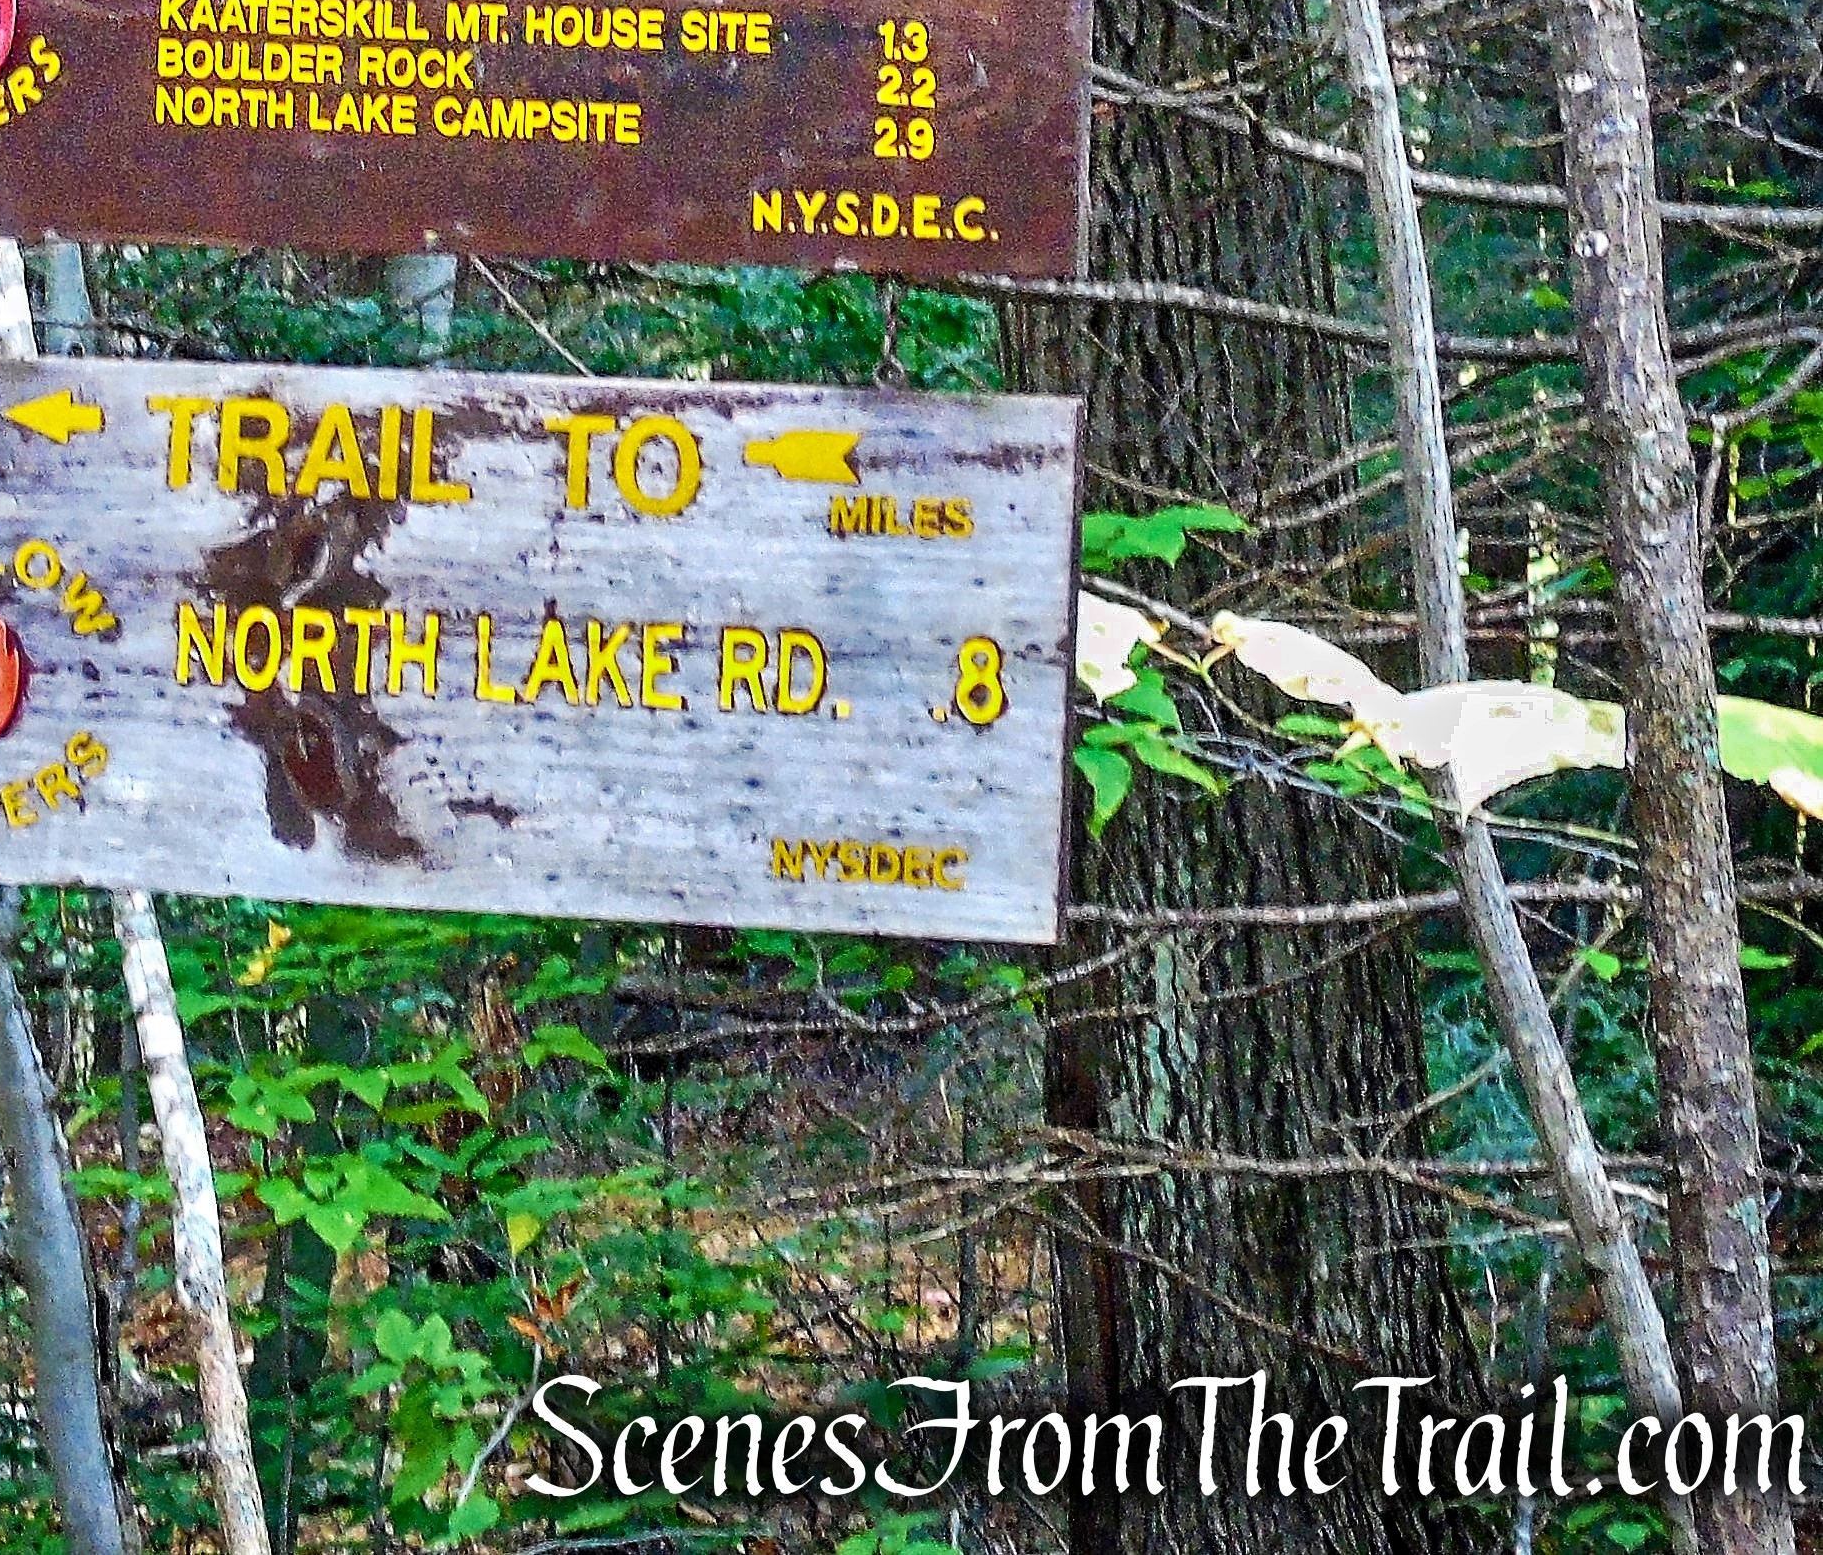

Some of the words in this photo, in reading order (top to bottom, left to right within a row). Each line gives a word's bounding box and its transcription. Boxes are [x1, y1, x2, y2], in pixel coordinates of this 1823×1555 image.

[445, 3, 510, 45] MT.
[524, 6, 664, 51] HOUSE
[680, 12, 774, 55] SITE
[879, 20, 929, 62] 1.3
[156, 38, 342, 85] BOULDER
[359, 46, 475, 91] ROCK
[877, 66, 937, 109] 2.2
[155, 87, 294, 130] NORTH
[308, 94, 418, 136] LAKE
[433, 98, 641, 145] CAMPSITE
[873, 118, 936, 161] 2.9
[752, 190, 1000, 242] N.Y.S.D.E.C.
[146, 394, 472, 506] TRAIL
[544, 413, 702, 517] TO
[829, 494, 975, 540] MILES
[175, 600, 441, 698] NORTH
[476, 612, 686, 711] LAKE
[717, 624, 852, 718] RD.
[931, 635, 1008, 727] .8
[769, 838, 970, 891] NYSDEC
